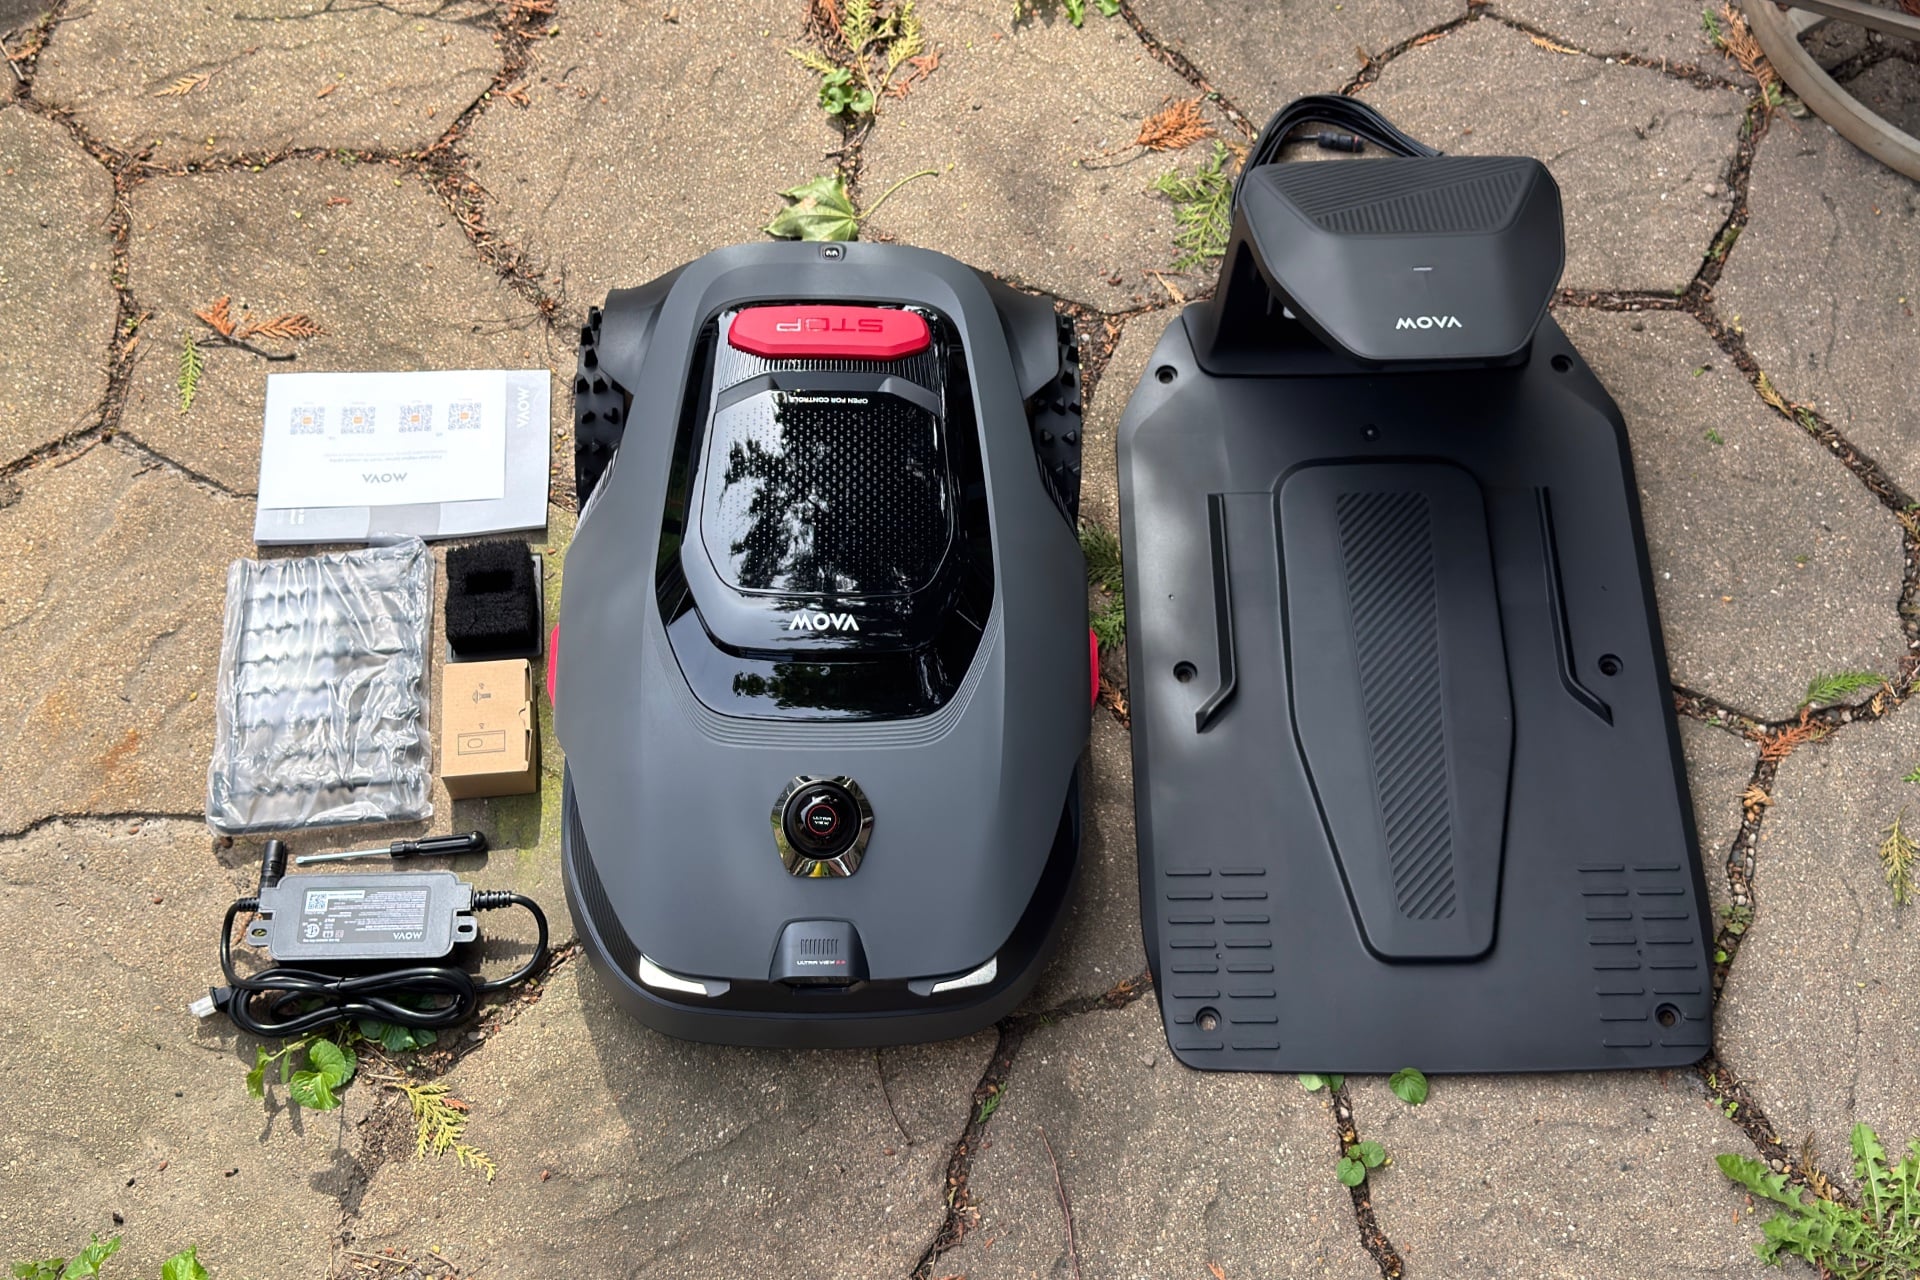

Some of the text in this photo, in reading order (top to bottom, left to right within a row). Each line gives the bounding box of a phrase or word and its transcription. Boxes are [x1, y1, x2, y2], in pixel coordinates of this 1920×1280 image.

[776, 317, 884, 333] STOP
[1395, 315, 1463, 330] MOVA
[517, 386, 532, 429] MOVA
[361, 471, 408, 484] MOVA
[788, 613, 860, 631] MOVA
[392, 931, 423, 940] MOVA
